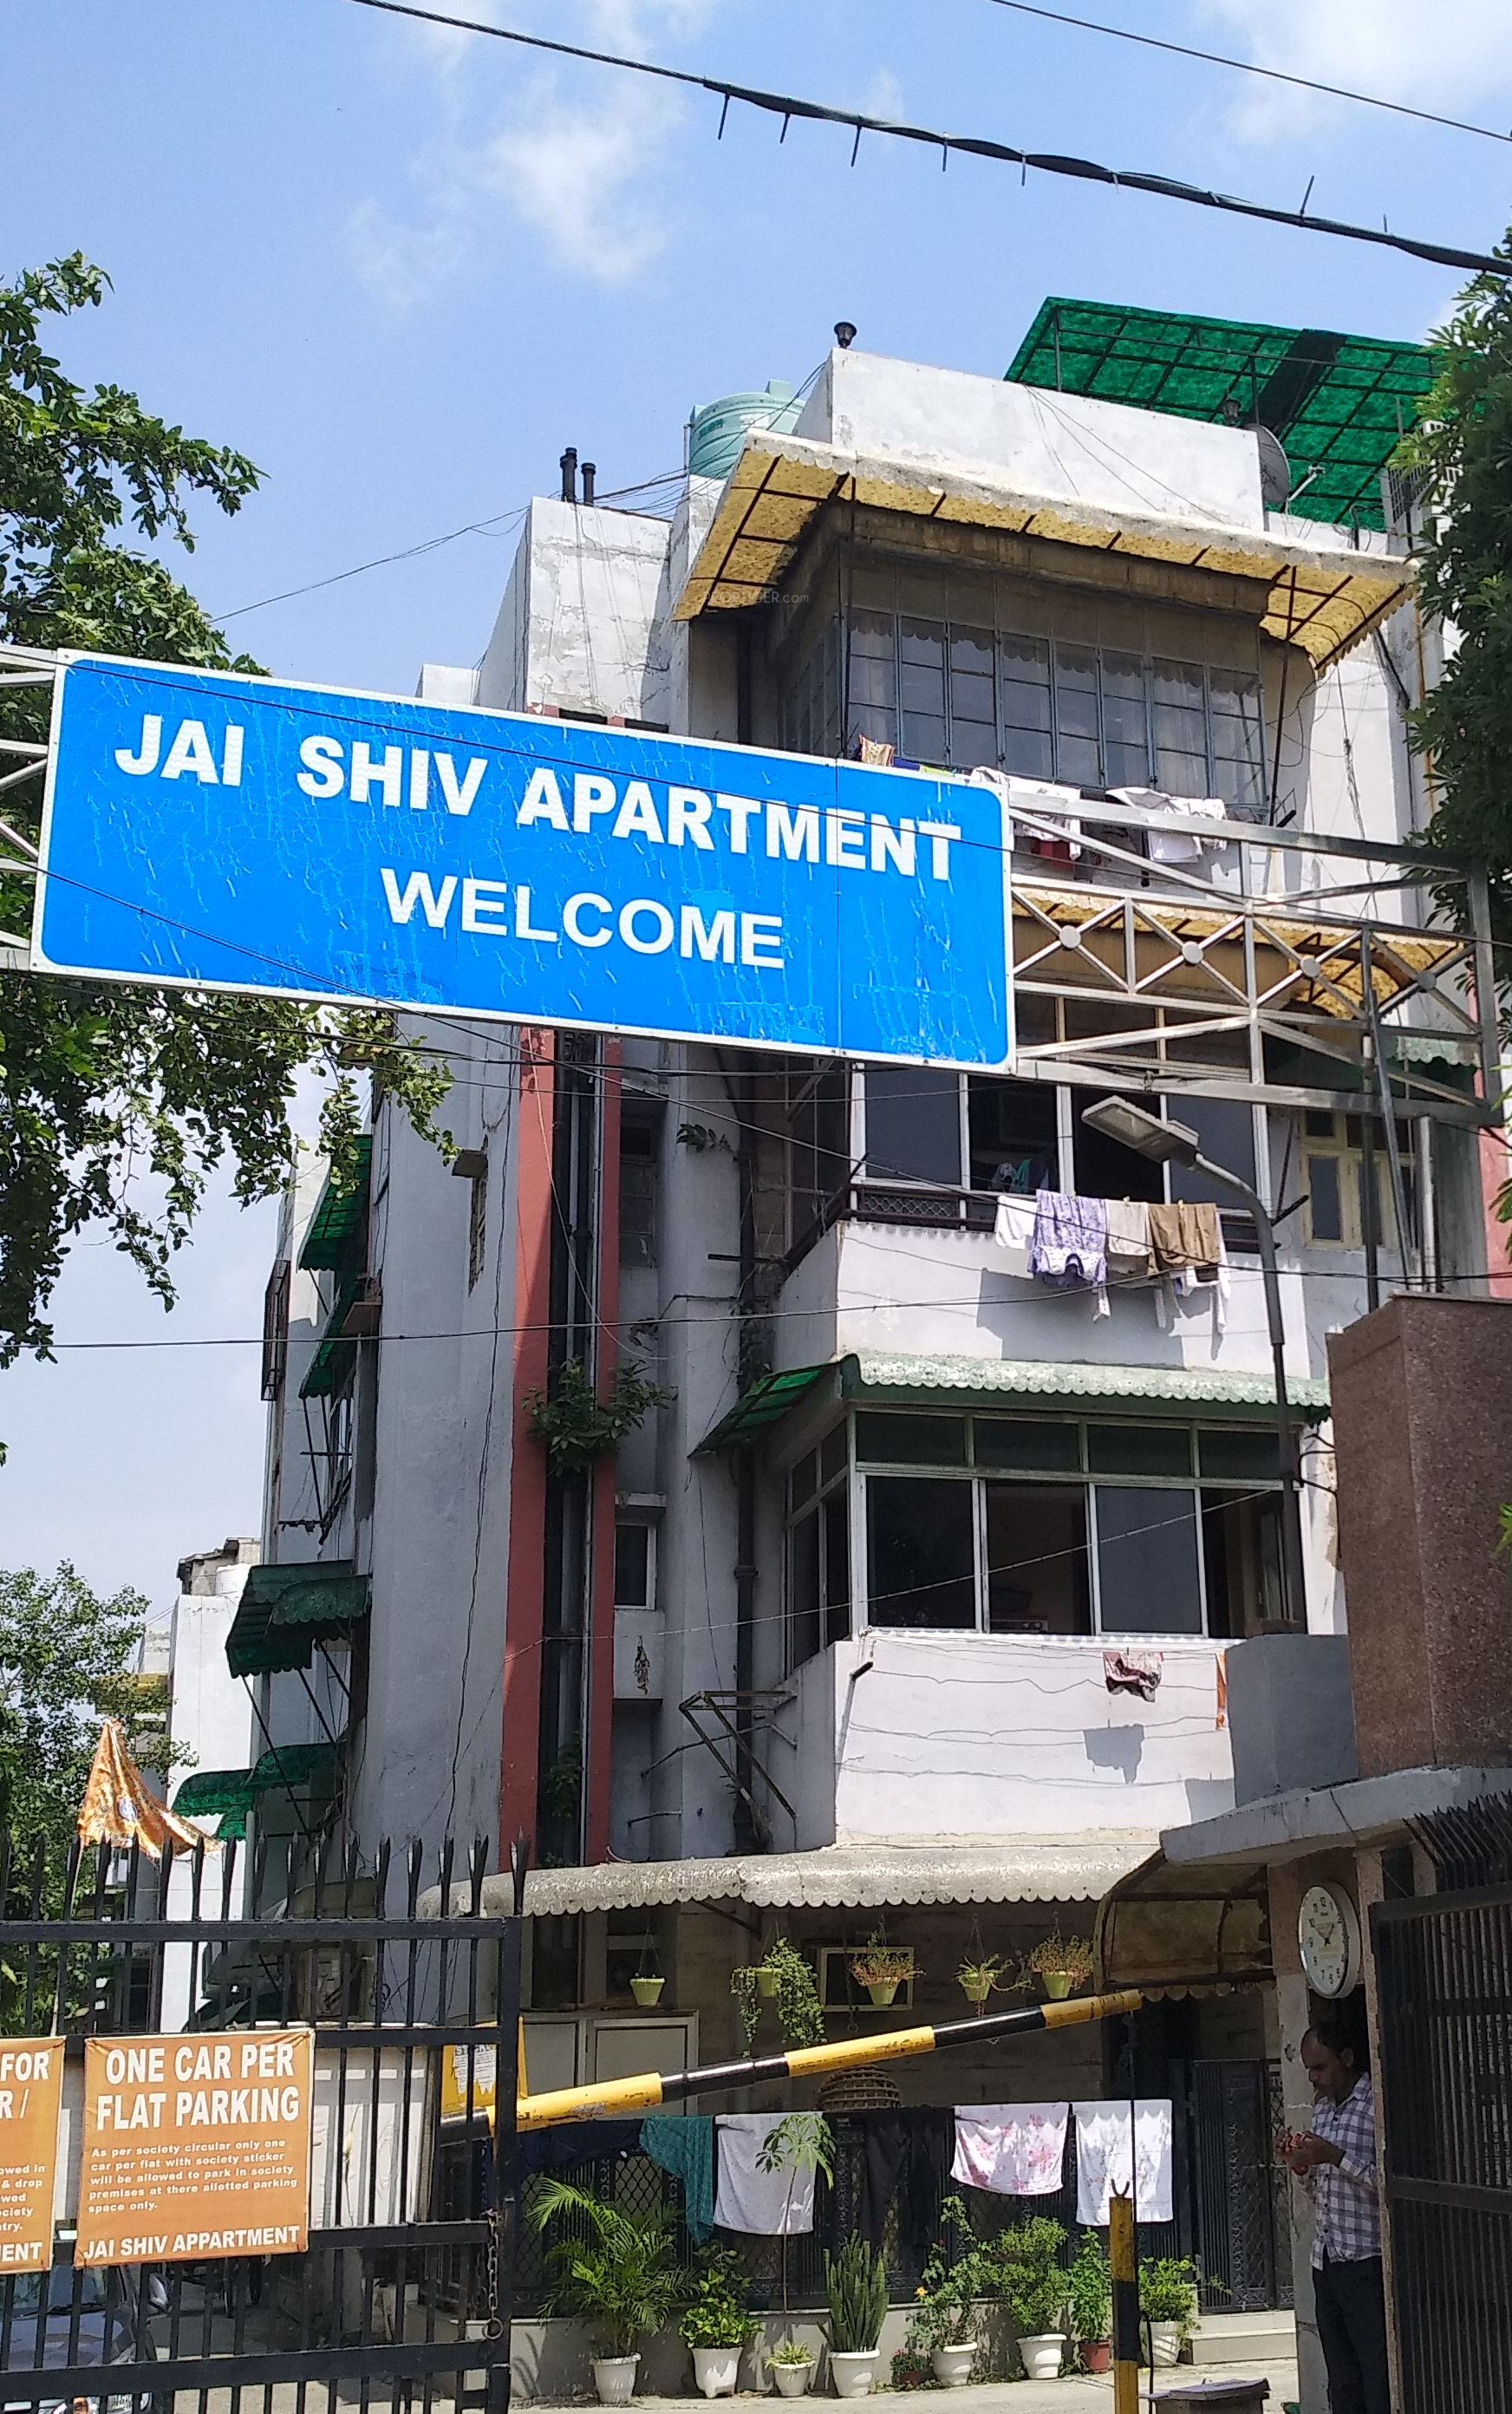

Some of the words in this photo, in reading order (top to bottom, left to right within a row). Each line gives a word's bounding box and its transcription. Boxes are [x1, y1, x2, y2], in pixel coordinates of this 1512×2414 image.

[114, 714, 244, 786] JAI
[297, 735, 488, 816] SHIV
[515, 767, 961, 881] APARTMENT
[380, 867, 785, 969] WELCOME
[0, 2052, 49, 2082] FOR
[106, 2047, 166, 2085] ONE
[175, 2045, 231, 2081] CAR
[241, 2043, 295, 2078] PER
[97, 2092, 166, 2130] FLAT
[176, 2085, 300, 2127] PARKING
[91, 2148, 107, 2157] As
[112, 2148, 132, 2158] per
[136, 2145, 180, 2156] society
[185, 2142, 231, 2151] circular
[235, 2140, 260, 2150] only
[264, 2139, 286, 2148] one
[34, 2163, 46, 2173] in
[90, 2163, 112, 2171] car
[115, 2161, 136, 2171] per
[140, 2158, 161, 2169] flat
[165, 2157, 192, 2167] with
[196, 2155, 240, 2165] society
[244, 2152, 285, 2163] sticker
[2, 2179, 10, 2189] &
[15, 2178, 42, 2189] drop
[90, 2175, 113, 2185] will
[117, 2174, 133, 2183] be
[137, 2170, 184, 2182] allowed
[187, 2170, 200, 2179] to
[204, 2169, 231, 2180] park
[236, 2167, 247, 2176] in
[251, 2165, 295, 2176] society
[0, 2192, 26, 2202] wed
[89, 2189, 146, 2201] premises
[149, 2187, 163, 2195] at
[166, 2184, 199, 2195] there
[203, 2181, 250, 2192] allotted
[253, 2179, 297, 2189] parking
[0, 2207, 34, 2217] ciety
[88, 2203, 126, 2215] space
[129, 2201, 158, 2211] only.
[0, 2222, 23, 2233] try.
[0, 2241, 42, 2262] ENT
[84, 2240, 114, 2260] JAI
[120, 2235, 168, 2255] SHIV
[173, 2225, 301, 2253] APPARTMENT
